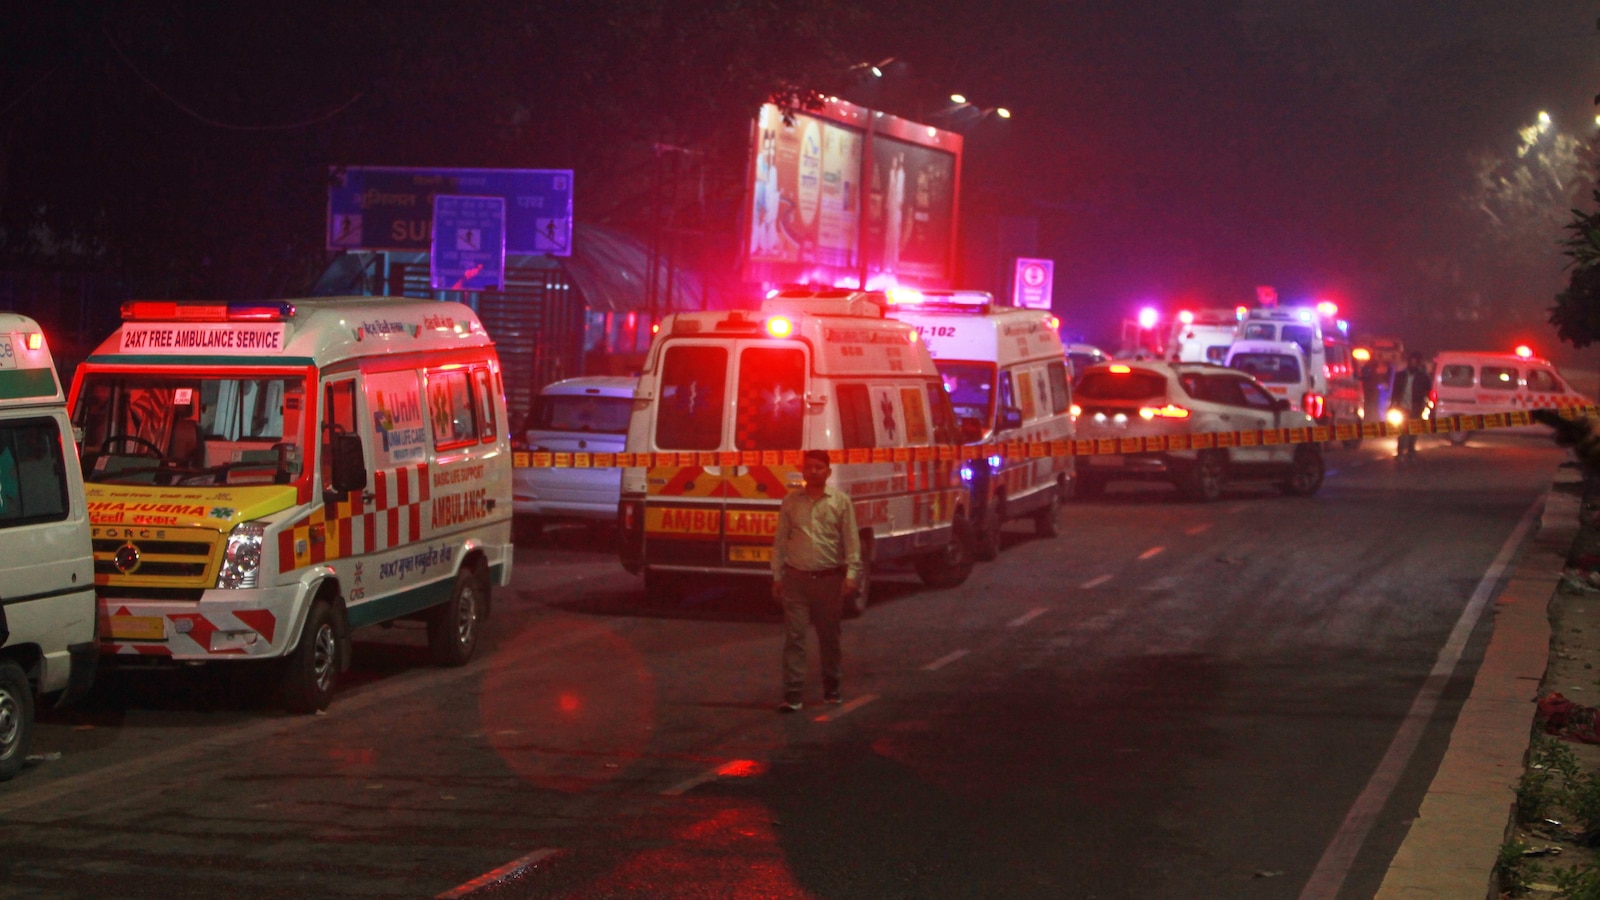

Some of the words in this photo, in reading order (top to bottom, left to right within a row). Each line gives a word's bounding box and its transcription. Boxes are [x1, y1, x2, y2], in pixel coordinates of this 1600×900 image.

[392, 220, 432, 241] SU
[124, 331, 148, 348] 24X7
[149, 330, 173, 348] FREE
[174, 330, 234, 348] AMBULANCE
[236, 331, 281, 349] SERVICE
[433, 471, 450, 488] BASIC
[450, 469, 462, 485] LIFE
[461, 465, 485, 483] SUPPORT
[431, 488, 487, 530] AMBULANCE
[661, 509, 778, 535] AMBULANC
[92, 528, 167, 539] FORCE
[379, 557, 399, 579] 24X7
